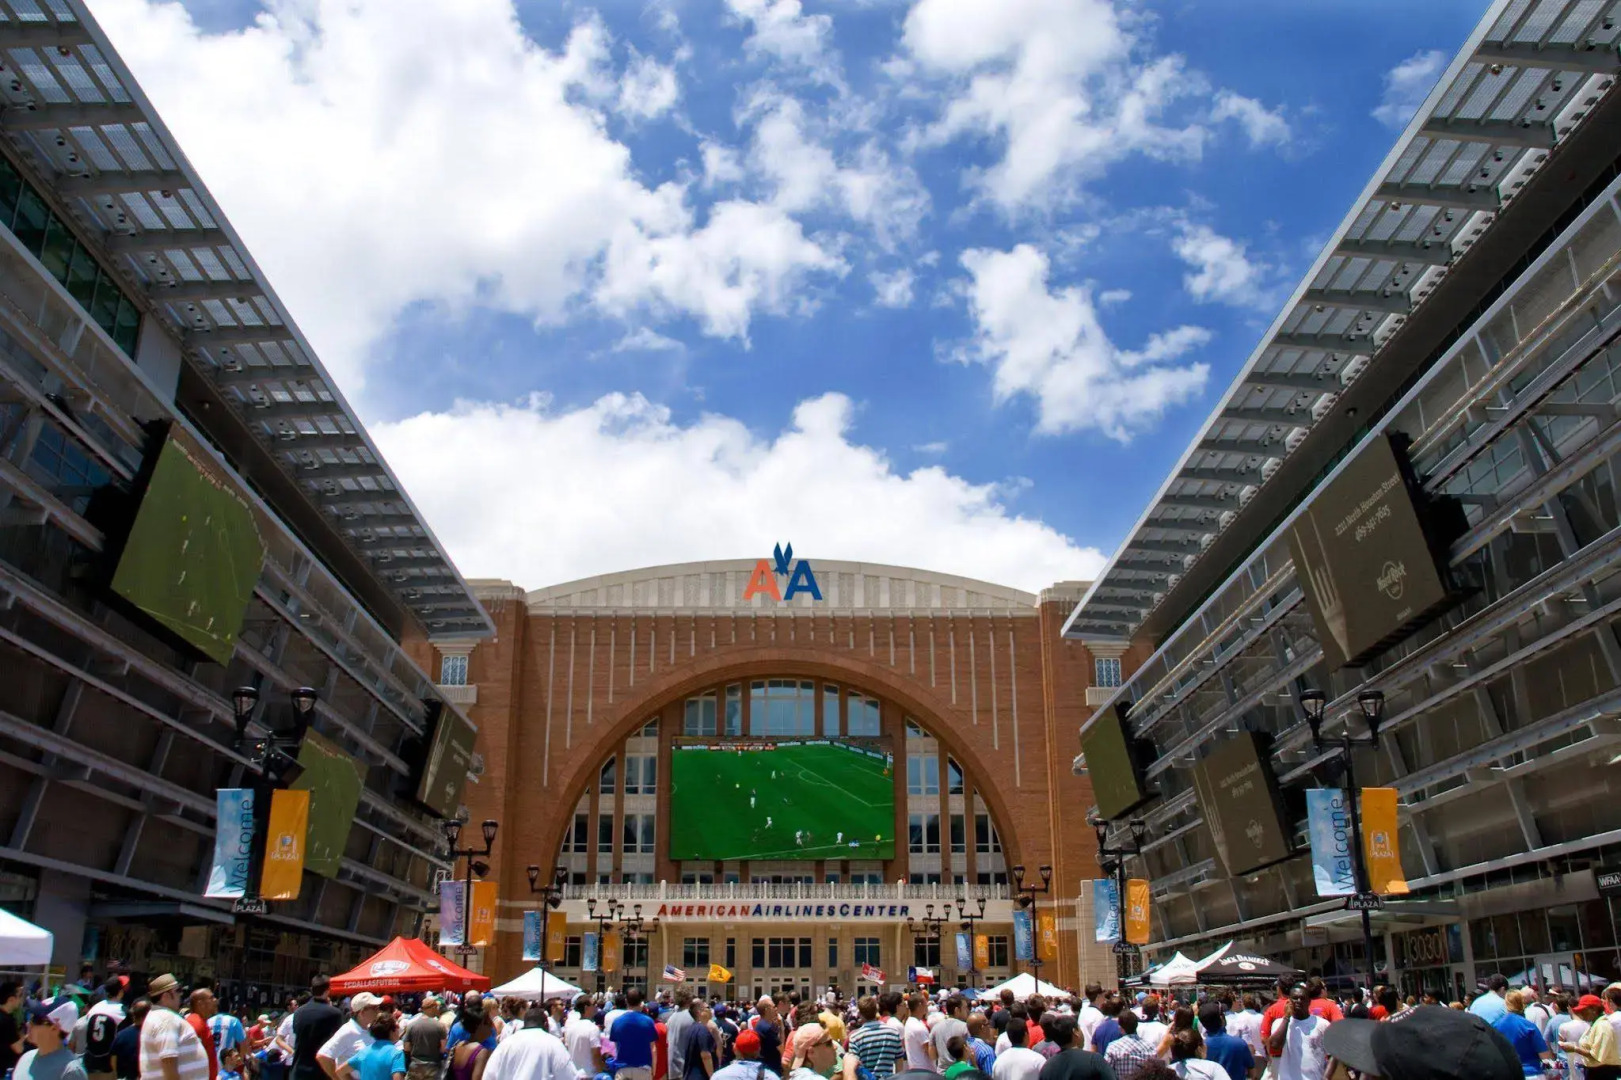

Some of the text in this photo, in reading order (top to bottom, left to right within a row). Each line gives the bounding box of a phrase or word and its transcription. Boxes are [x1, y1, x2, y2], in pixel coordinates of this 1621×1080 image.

[1381, 471, 1400, 493] Street
[228, 799, 254, 893] Welcome
[1331, 798, 1355, 891] Welcome
[236, 904, 262, 912] PLAZA
[657, 903, 909, 917] AMERICAN AIRLINES CENTER
[1354, 901, 1379, 909] PLAZA
[1218, 955, 1238, 966] JACK
[92, 1015, 108, 1042] 5
